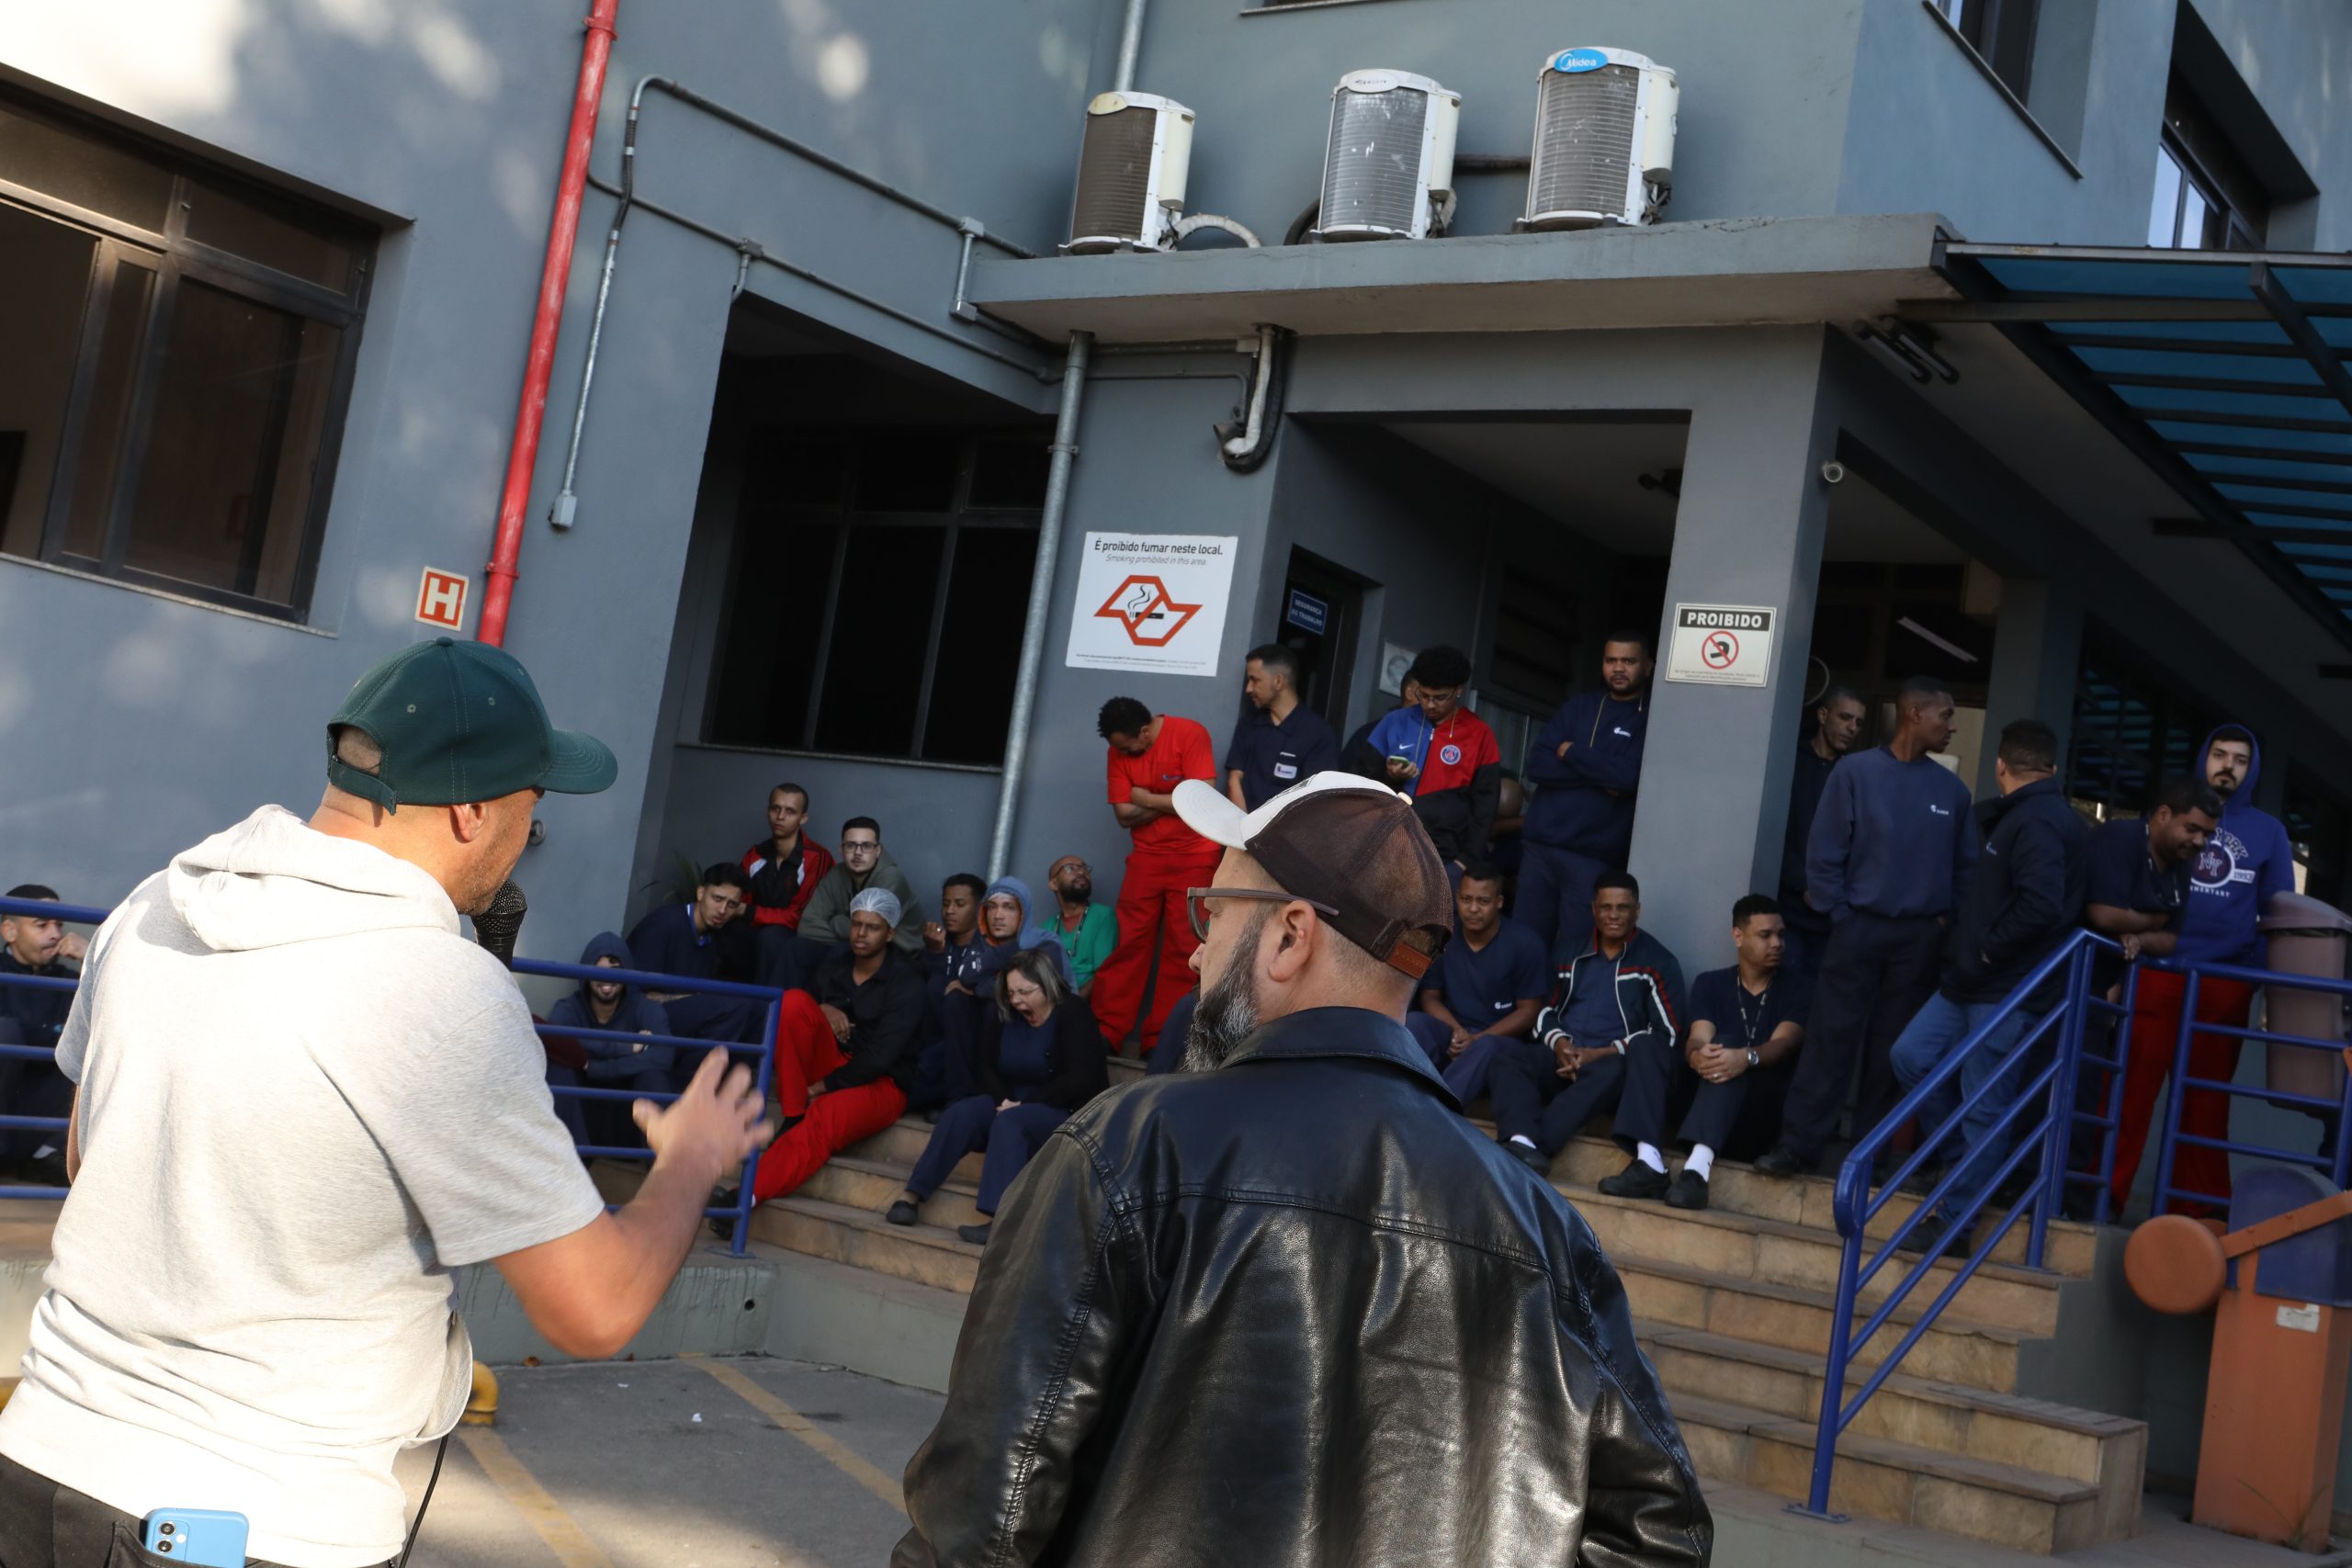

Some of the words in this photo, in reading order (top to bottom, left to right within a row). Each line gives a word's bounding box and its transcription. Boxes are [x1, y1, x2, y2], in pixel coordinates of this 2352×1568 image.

[1561, 55, 1597, 70] Midea
[1094, 537, 1102, 550] É
[1102, 541, 1139, 553] proibido
[1141, 542, 1169, 553] fumar
[1170, 544, 1196, 554] neste
[1198, 544, 1223, 555] local.
[1105, 554, 1134, 565] Smoking
[1135, 555, 1169, 565] prohibited
[1170, 556, 1177, 564] in
[1177, 556, 1190, 565] this
[424, 577, 460, 621] H
[1687, 612, 1762, 628] PROIBIDO
[2214, 827, 2249, 861] YORK
[2199, 851, 2223, 876] NY
[2189, 885, 2230, 897] EMENTARY
